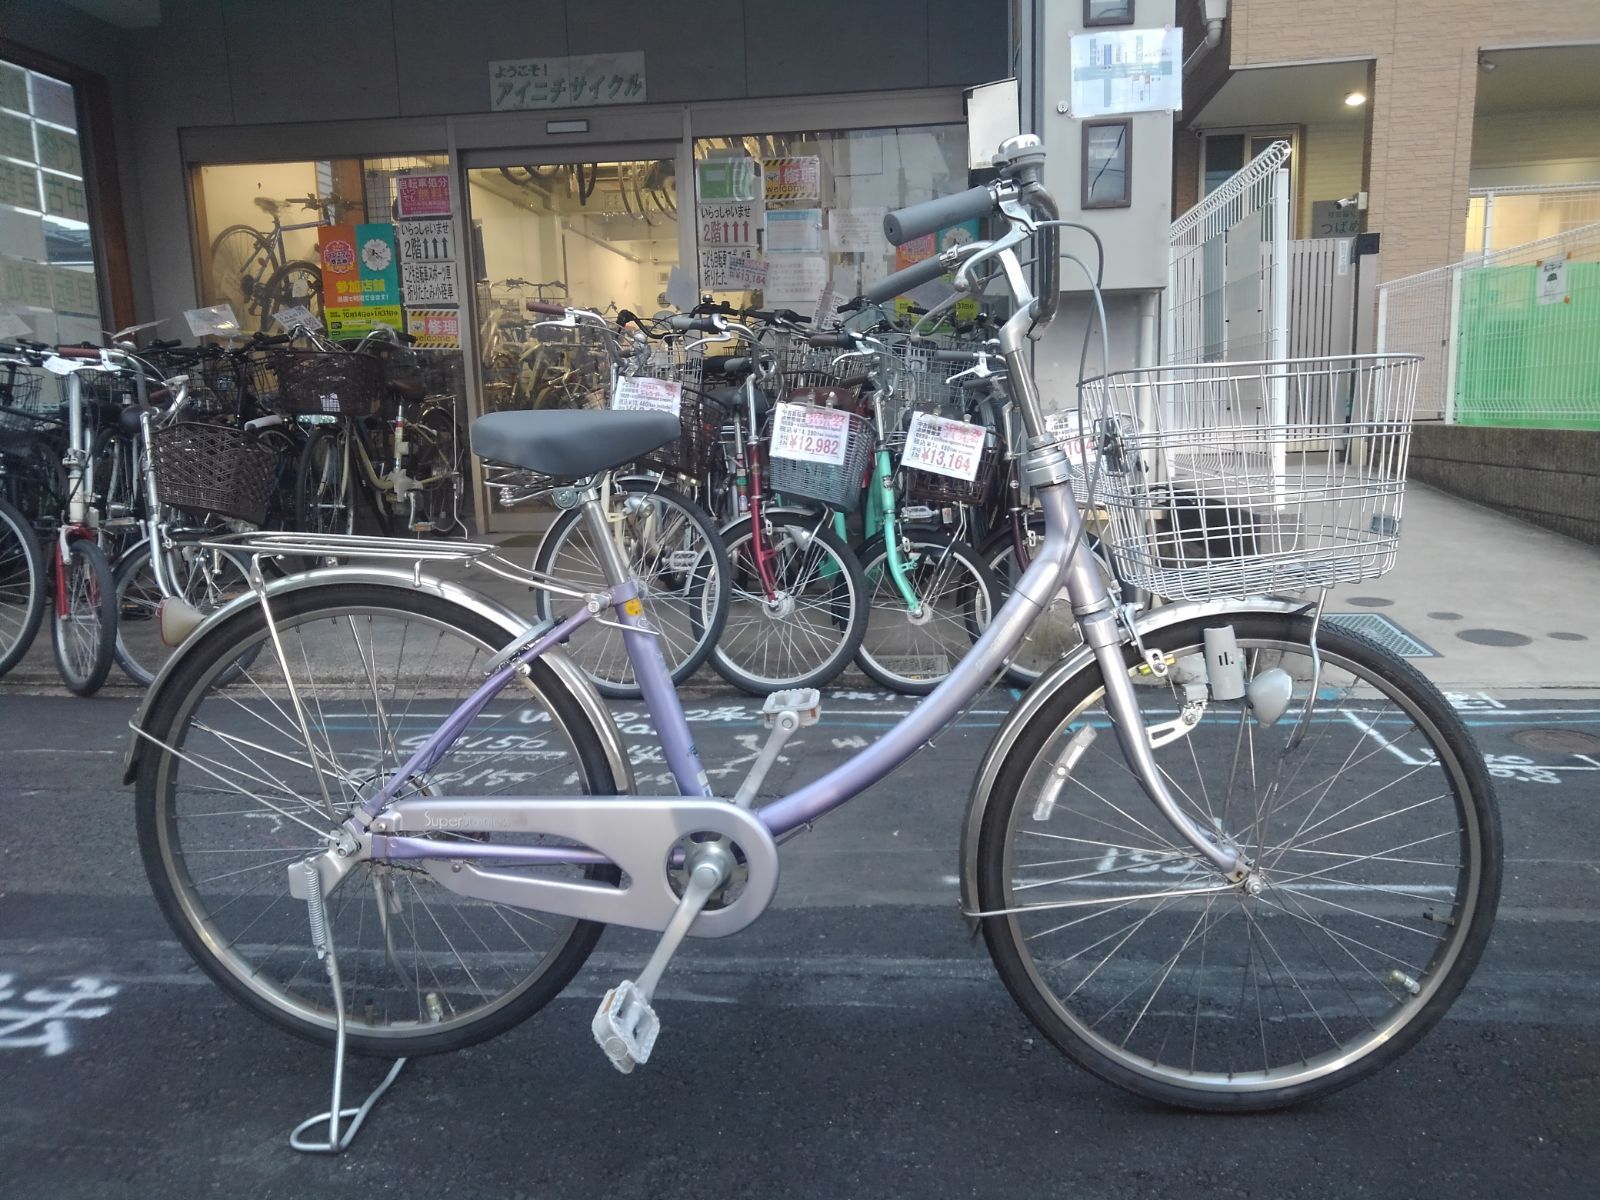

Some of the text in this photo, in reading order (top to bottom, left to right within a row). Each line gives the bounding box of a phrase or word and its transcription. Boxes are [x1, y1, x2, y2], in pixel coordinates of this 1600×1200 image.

[496, 73, 643, 105] アイニチサイクル
[701, 205, 751, 219] いらっしゃいませ
[401, 222, 449, 235] いらっしゃいませ
[428, 319, 458, 335] 修理
[789, 434, 839, 455] ¥12,982
[921, 447, 971, 472] ¥13,164
